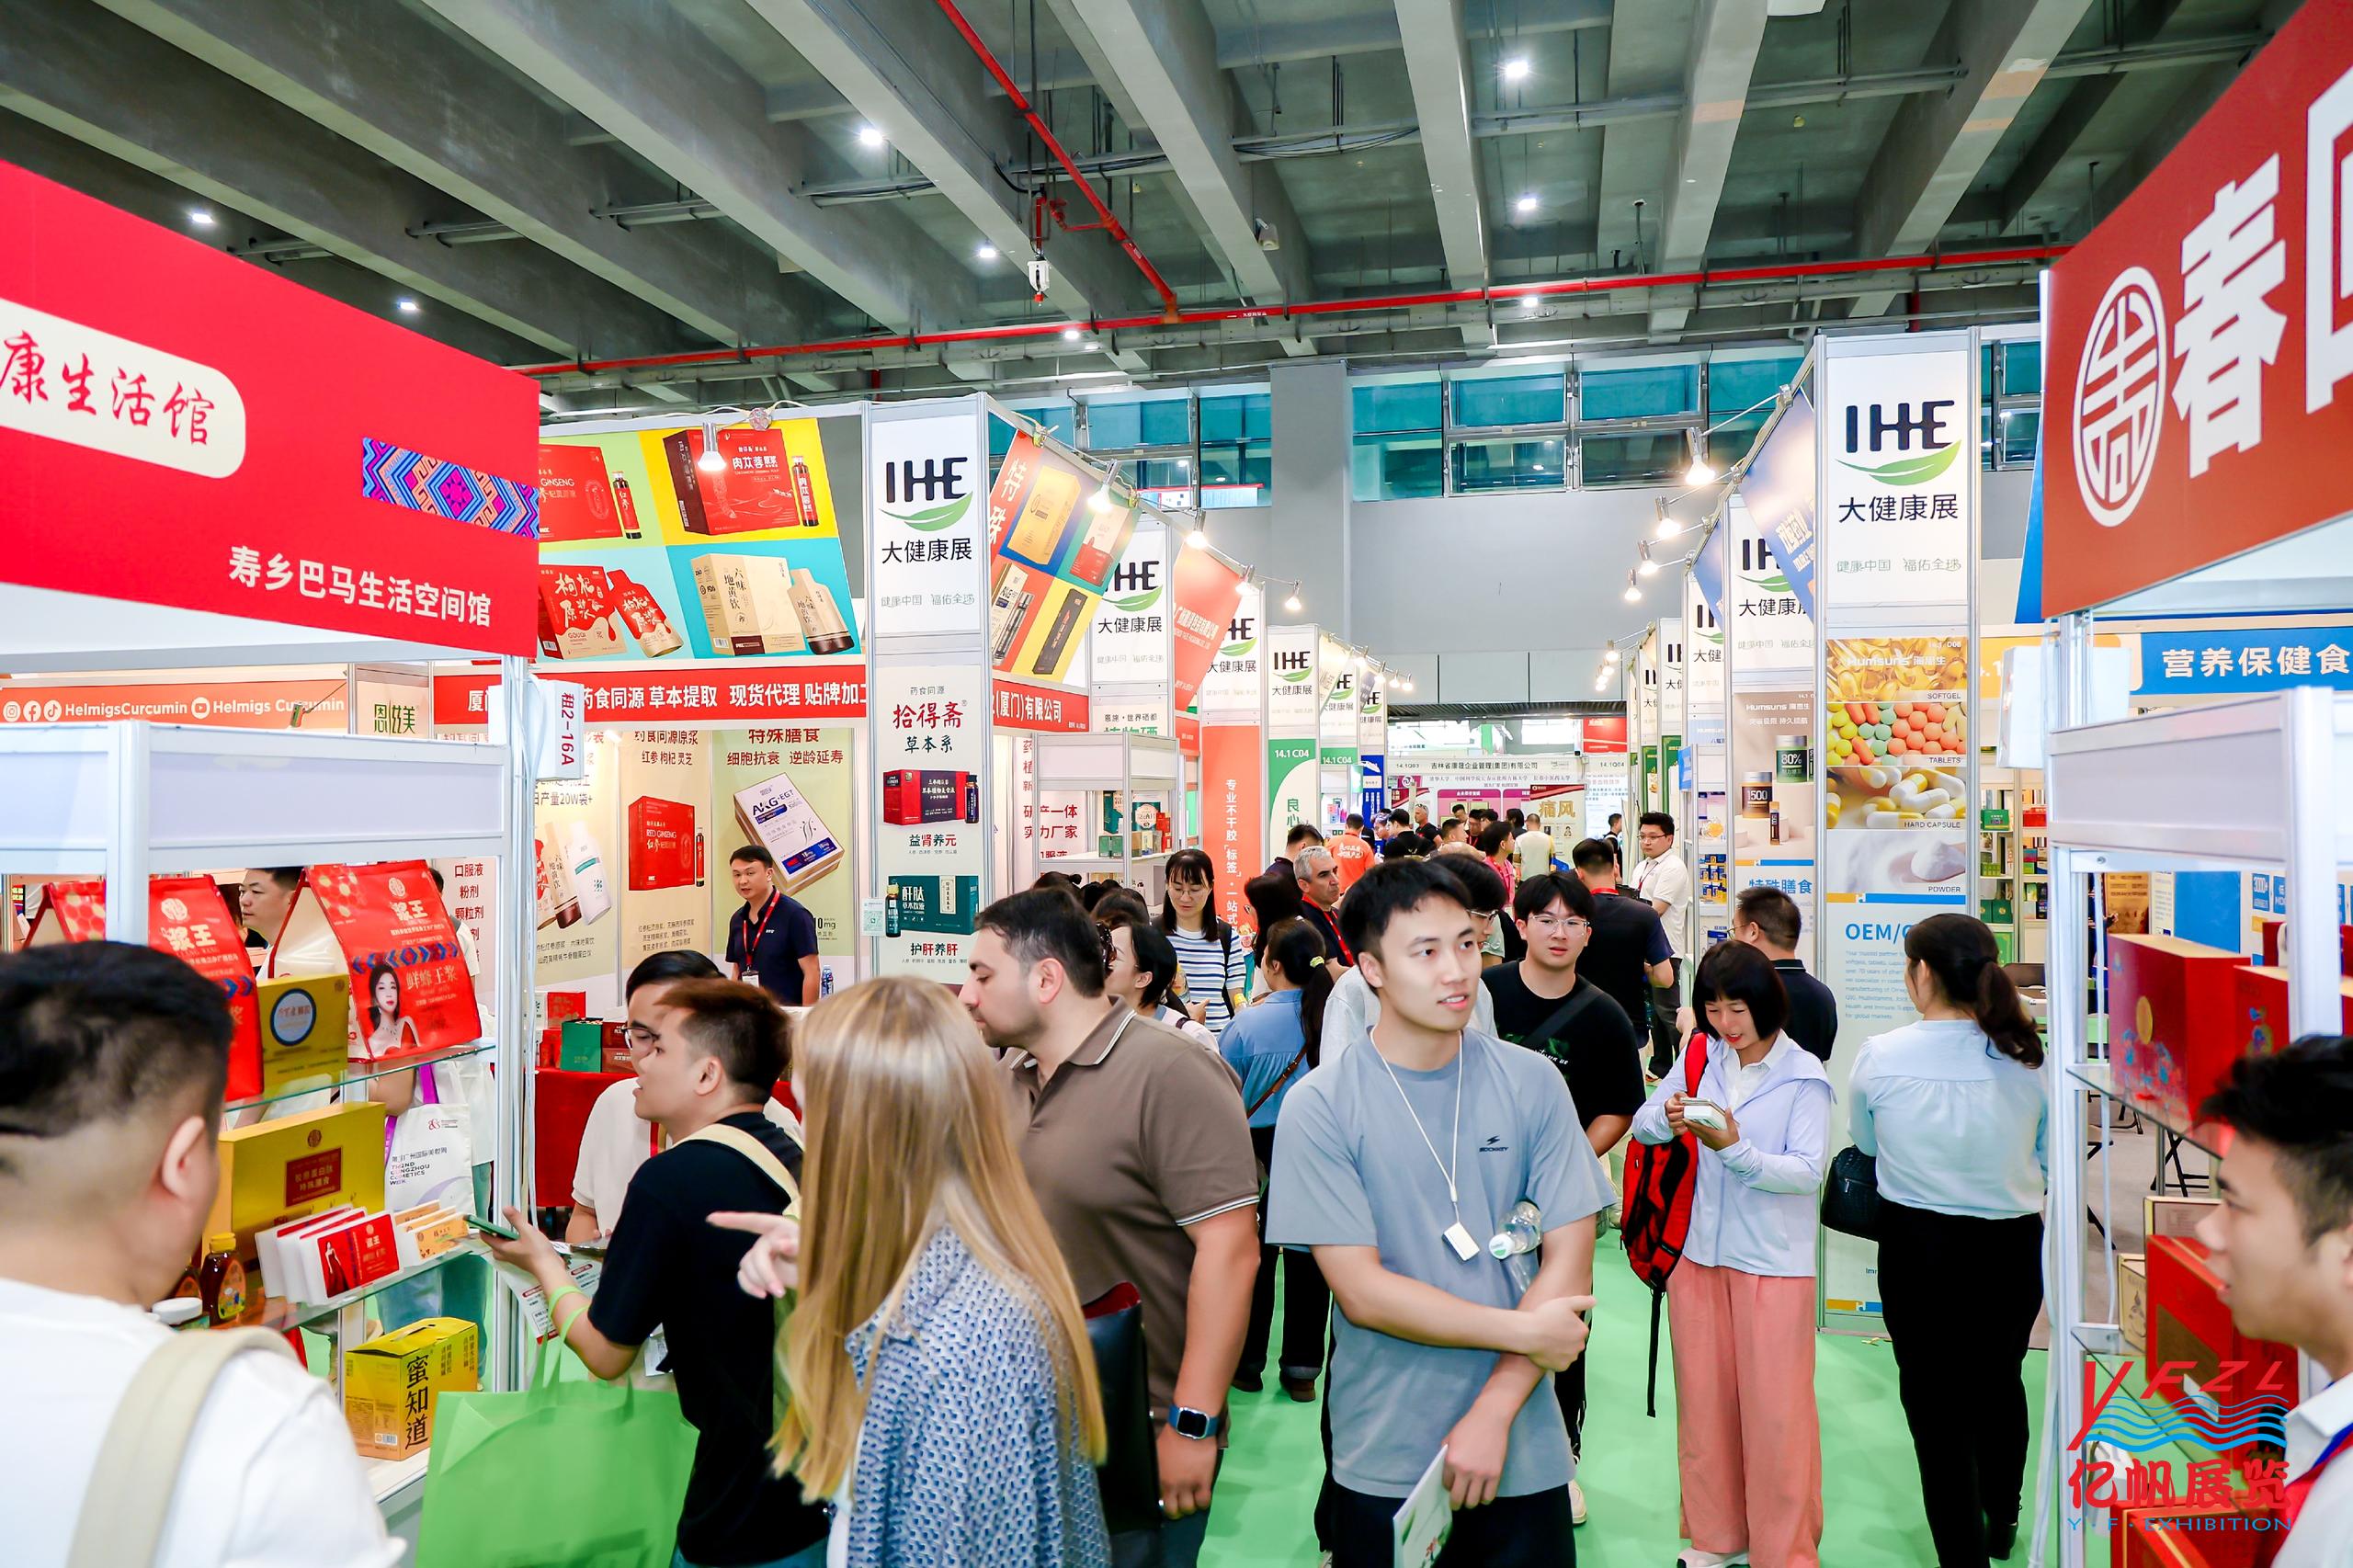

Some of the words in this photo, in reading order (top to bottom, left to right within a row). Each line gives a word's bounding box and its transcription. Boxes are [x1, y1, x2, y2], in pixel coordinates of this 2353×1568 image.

[1846, 400, 1955, 454] IHE
[540, 478, 575, 487] GINSENG
[885, 457, 969, 504] IHE
[1838, 494, 1959, 523] 大健康展
[881, 538, 972, 564] 大健康展
[1836, 558, 1892, 574] 健康中国
[1904, 558, 1961, 572] 福佑全球
[1106, 561, 1160, 592] HE
[228, 545, 493, 629] 寿乡巴马生活空间馆
[881, 594, 923, 608] 健康中国
[1097, 616, 1163, 634] 大健康展
[1208, 660, 1256, 673] 大健康展
[1274, 652, 1312, 670] IHE
[2162, 644, 2351, 678] 营养保健食
[649, 686, 718, 709] 草本提取
[729, 684, 801, 706] 现货代理
[909, 684, 946, 697] 药食同源
[1272, 686, 1313, 696] 大健康展
[64, 702, 188, 718] HelmigsCurcumin
[212, 699, 271, 715] Helmigs
[275, 698, 345, 712] Cuumin
[892, 701, 964, 730] 拾得斋
[748, 728, 821, 744] 特殊膳食
[904, 735, 954, 755] 草本系
[1274, 749, 1290, 757] 14.1
[1292, 749, 1309, 757] C04
[642, 751, 658, 764] 红参
[660, 751, 676, 766] 枸杞
[727, 752, 780, 766] 细胞抗衰
[790, 750, 844, 765] 逆龄延寿
[1780, 754, 1802, 765] 80%
[1928, 756, 1961, 765] TABLETS
[1747, 790, 1768, 801] 1500
[1287, 798, 1300, 828] 良心
[1539, 800, 1576, 818] 痛风
[1024, 825, 1078, 839] 实力厂家
[1904, 821, 1924, 829] HARD
[1925, 821, 1962, 829] CAPSULE
[909, 834, 957, 846] 益肾养元
[1224, 779, 1242, 931] 专业不干胶「标签」·一站式
[454, 863, 483, 878] 口服液
[460, 885, 479, 899] 粉剂
[1928, 885, 1961, 893] POWDER
[455, 906, 484, 920] 颗粒剂
[911, 943, 959, 956] 护肝养肝
[406, 965, 458, 991] 鲜蜂王浆
[404, 1354, 429, 1450] 蜜知道
